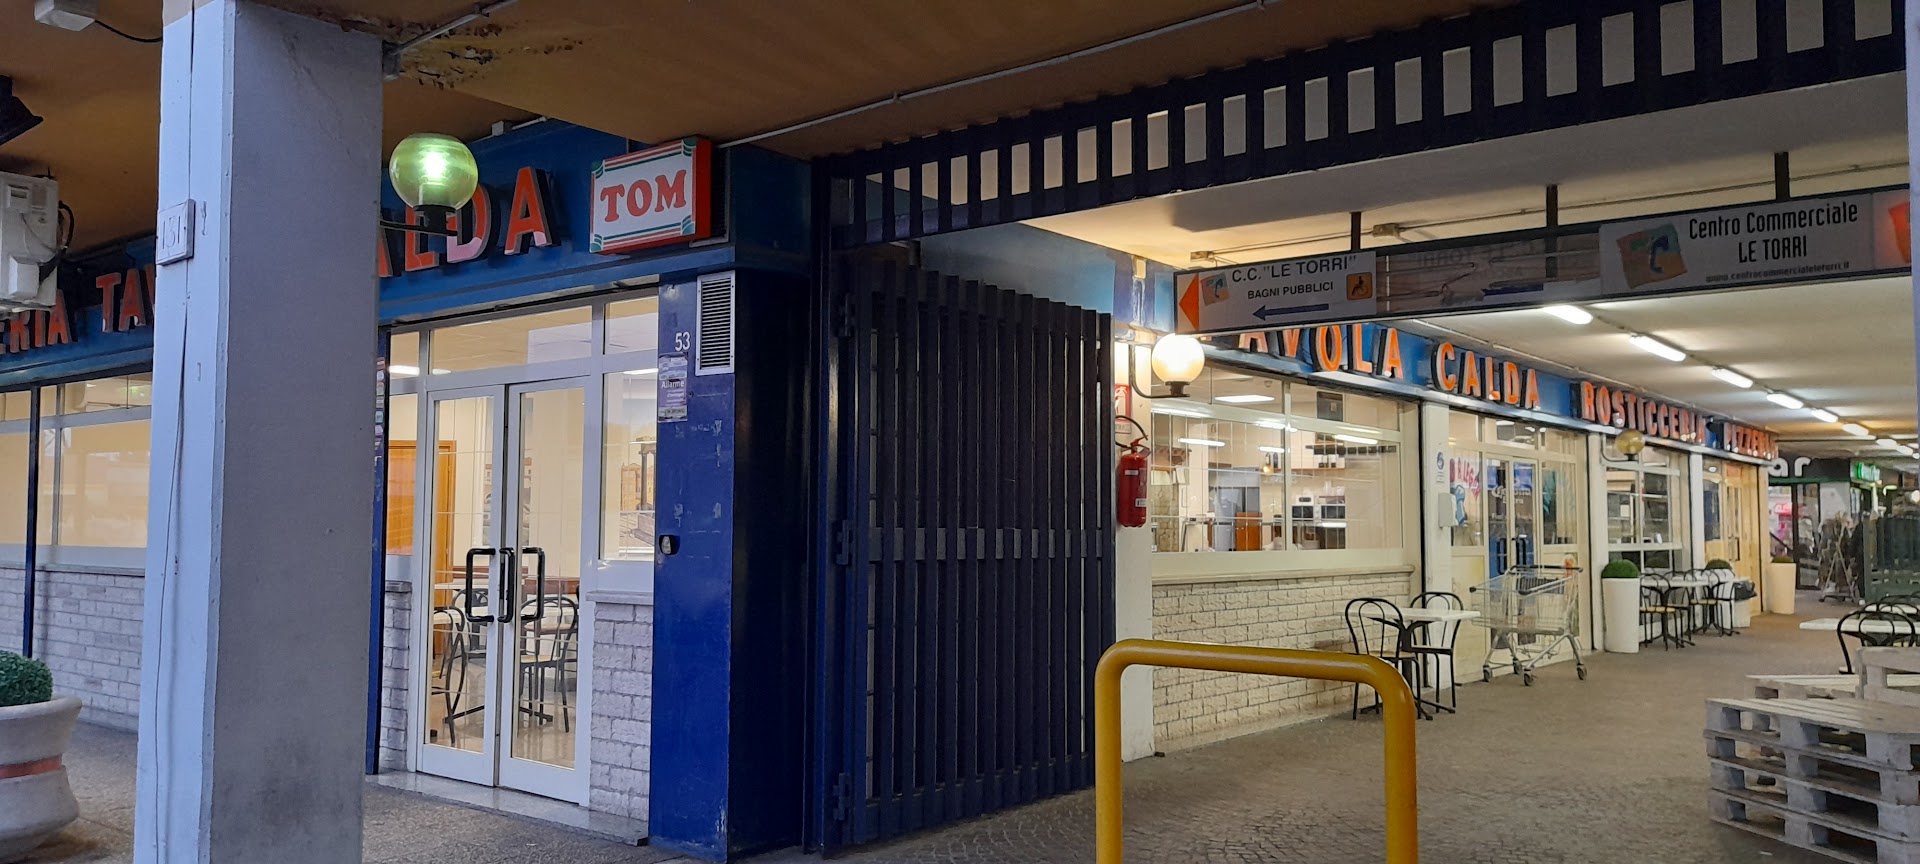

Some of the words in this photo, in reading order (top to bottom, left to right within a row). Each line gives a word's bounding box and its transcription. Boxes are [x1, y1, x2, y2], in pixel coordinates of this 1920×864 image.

[601, 170, 686, 222] TOM
[1689, 216, 1740, 239] Centro
[1747, 202, 1858, 233] Commerciale
[1738, 240, 1757, 263] LE
[1763, 236, 1807, 260] TORRI
[1247, 288, 1280, 300] BAGNI
[1283, 281, 1334, 296] PUBBLICI
[0, 289, 69, 354] RIA
[675, 332, 691, 352] 53
[661, 380, 685, 389] Allarme
[1437, 341, 1541, 411] CALDA
[1581, 381, 1706, 445] ROSTICCERIA
